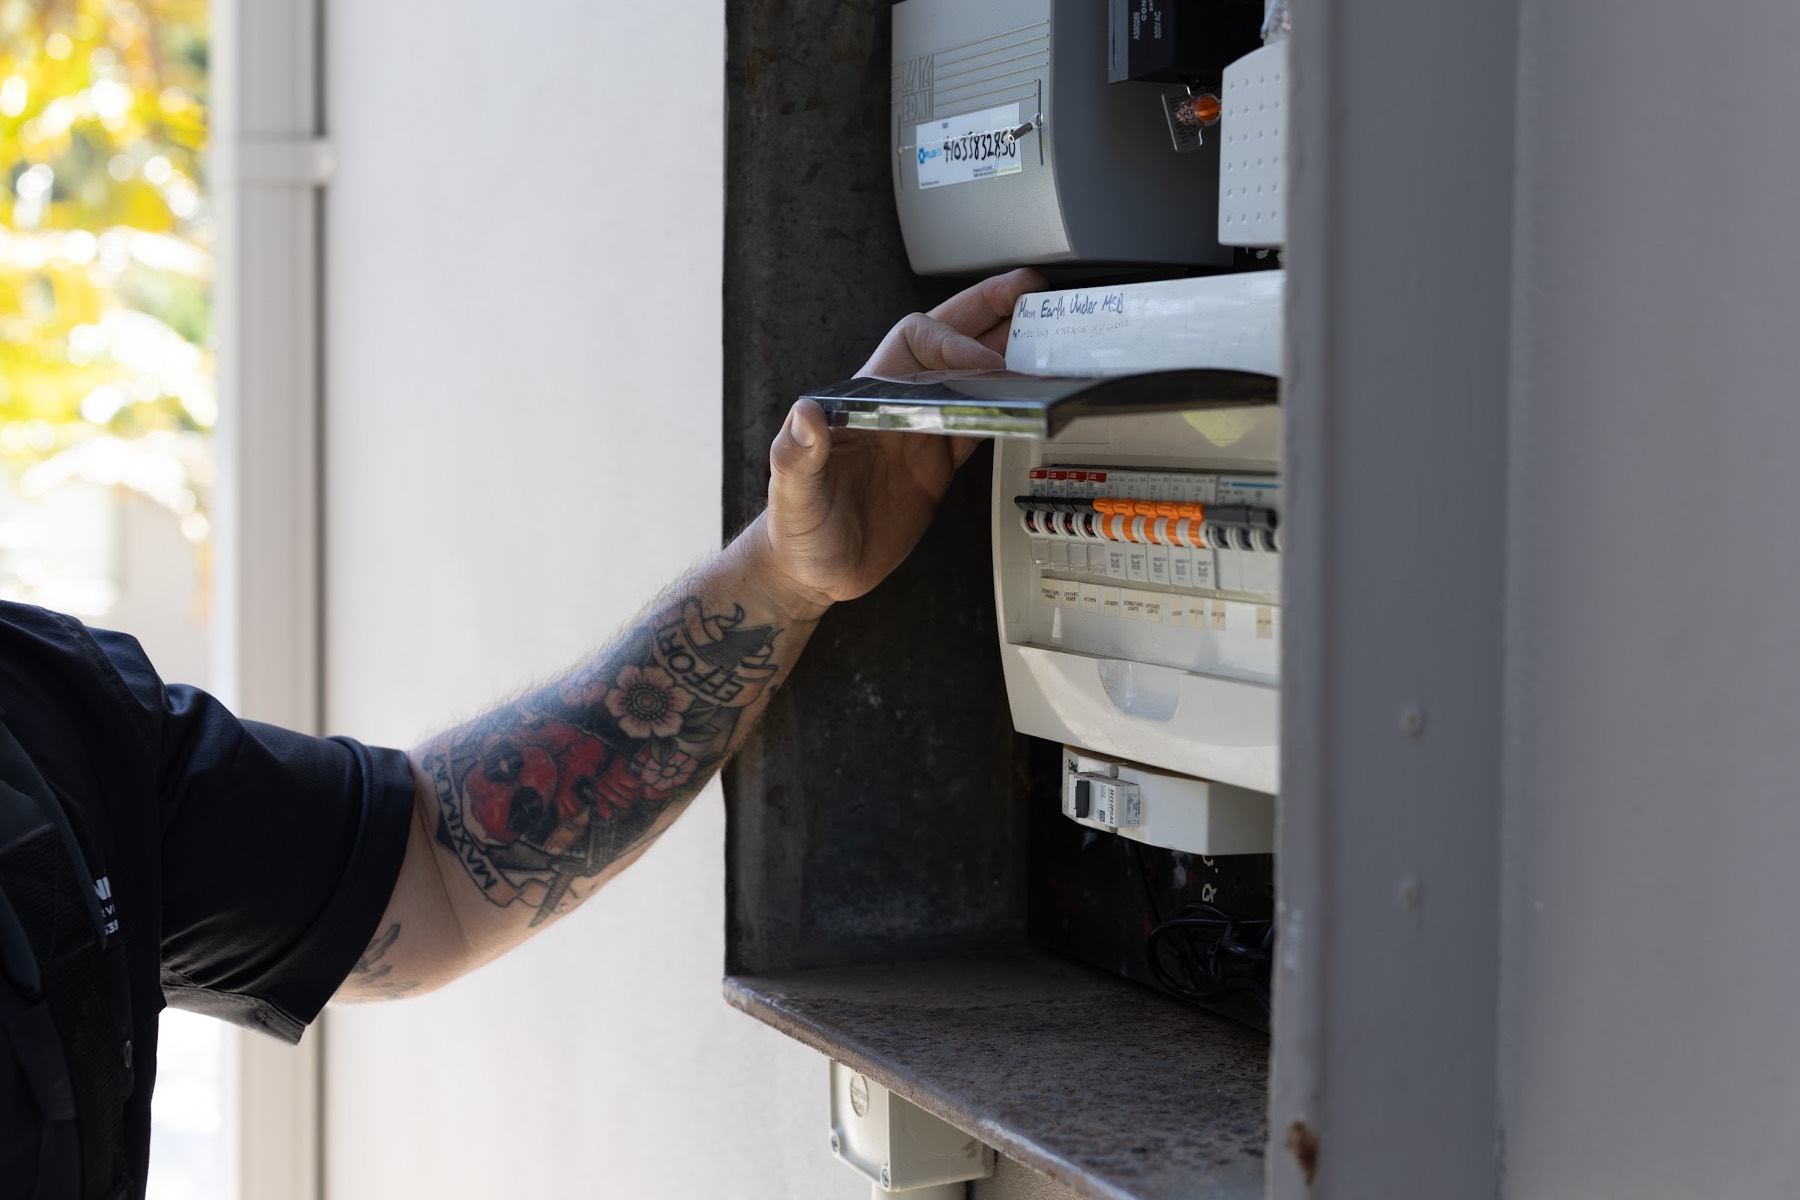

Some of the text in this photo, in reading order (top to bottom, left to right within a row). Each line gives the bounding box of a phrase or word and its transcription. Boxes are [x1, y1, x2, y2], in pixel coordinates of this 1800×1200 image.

[1040, 296, 1065, 320] Earth
[1070, 294, 1098, 315] Under
[433, 751, 499, 891] MAXIMUM
